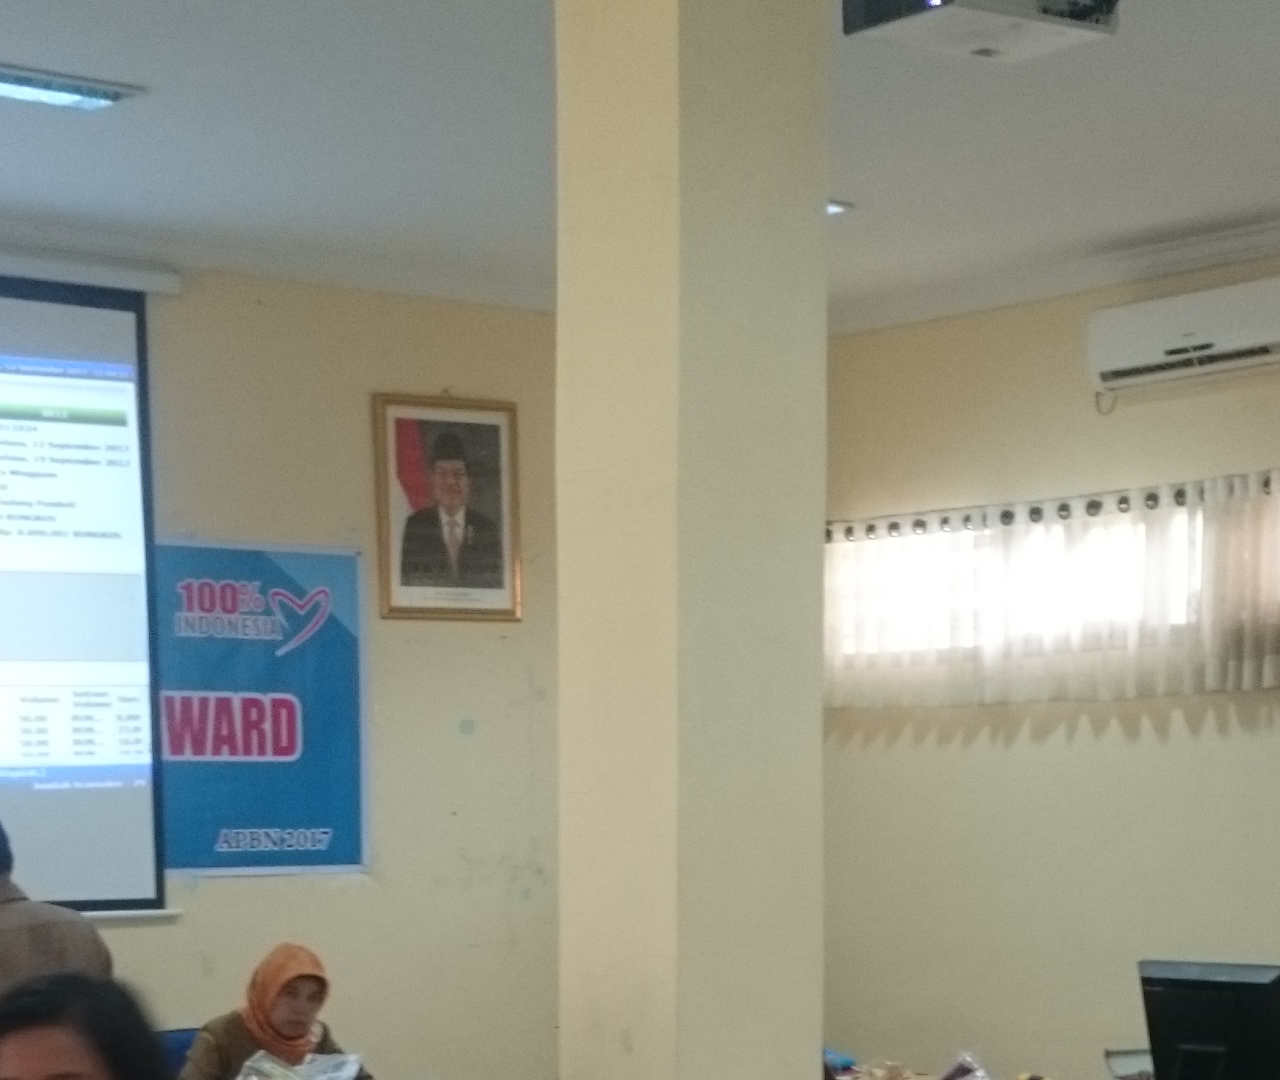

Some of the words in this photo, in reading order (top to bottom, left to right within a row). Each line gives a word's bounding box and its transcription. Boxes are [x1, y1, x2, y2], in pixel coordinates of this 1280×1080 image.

[179, 580, 266, 615] 100%
[176, 614, 282, 638] INDONESIA
[218, 830, 280, 850] APBN
[283, 830, 331, 849] 2017
